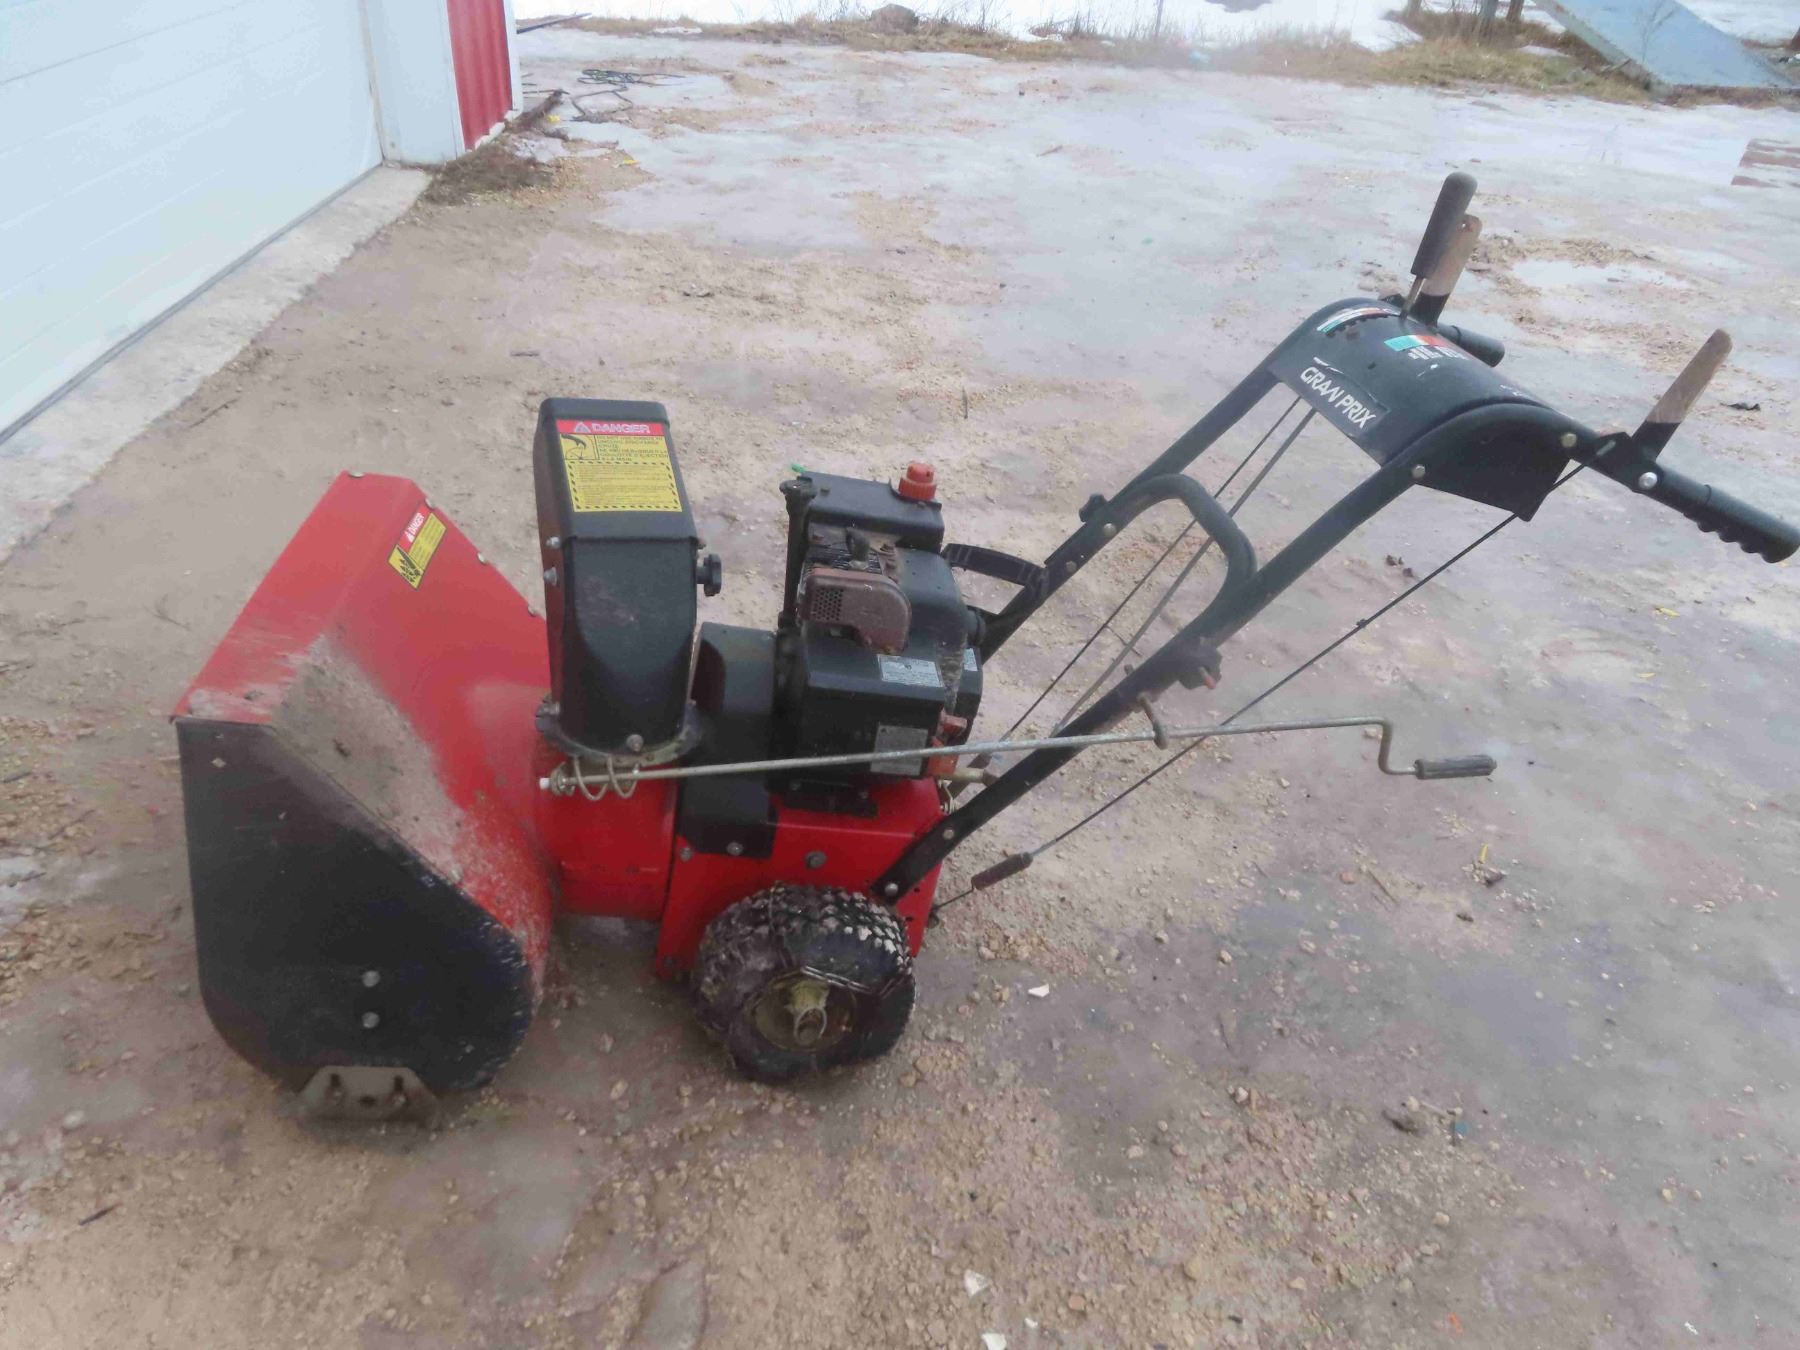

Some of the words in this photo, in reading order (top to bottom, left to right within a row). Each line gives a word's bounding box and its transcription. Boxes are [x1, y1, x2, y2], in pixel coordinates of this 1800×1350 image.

[1300, 366, 1345, 403] GRAN
[1334, 394, 1377, 429] PRIX
[592, 423, 650, 434] DANGER
